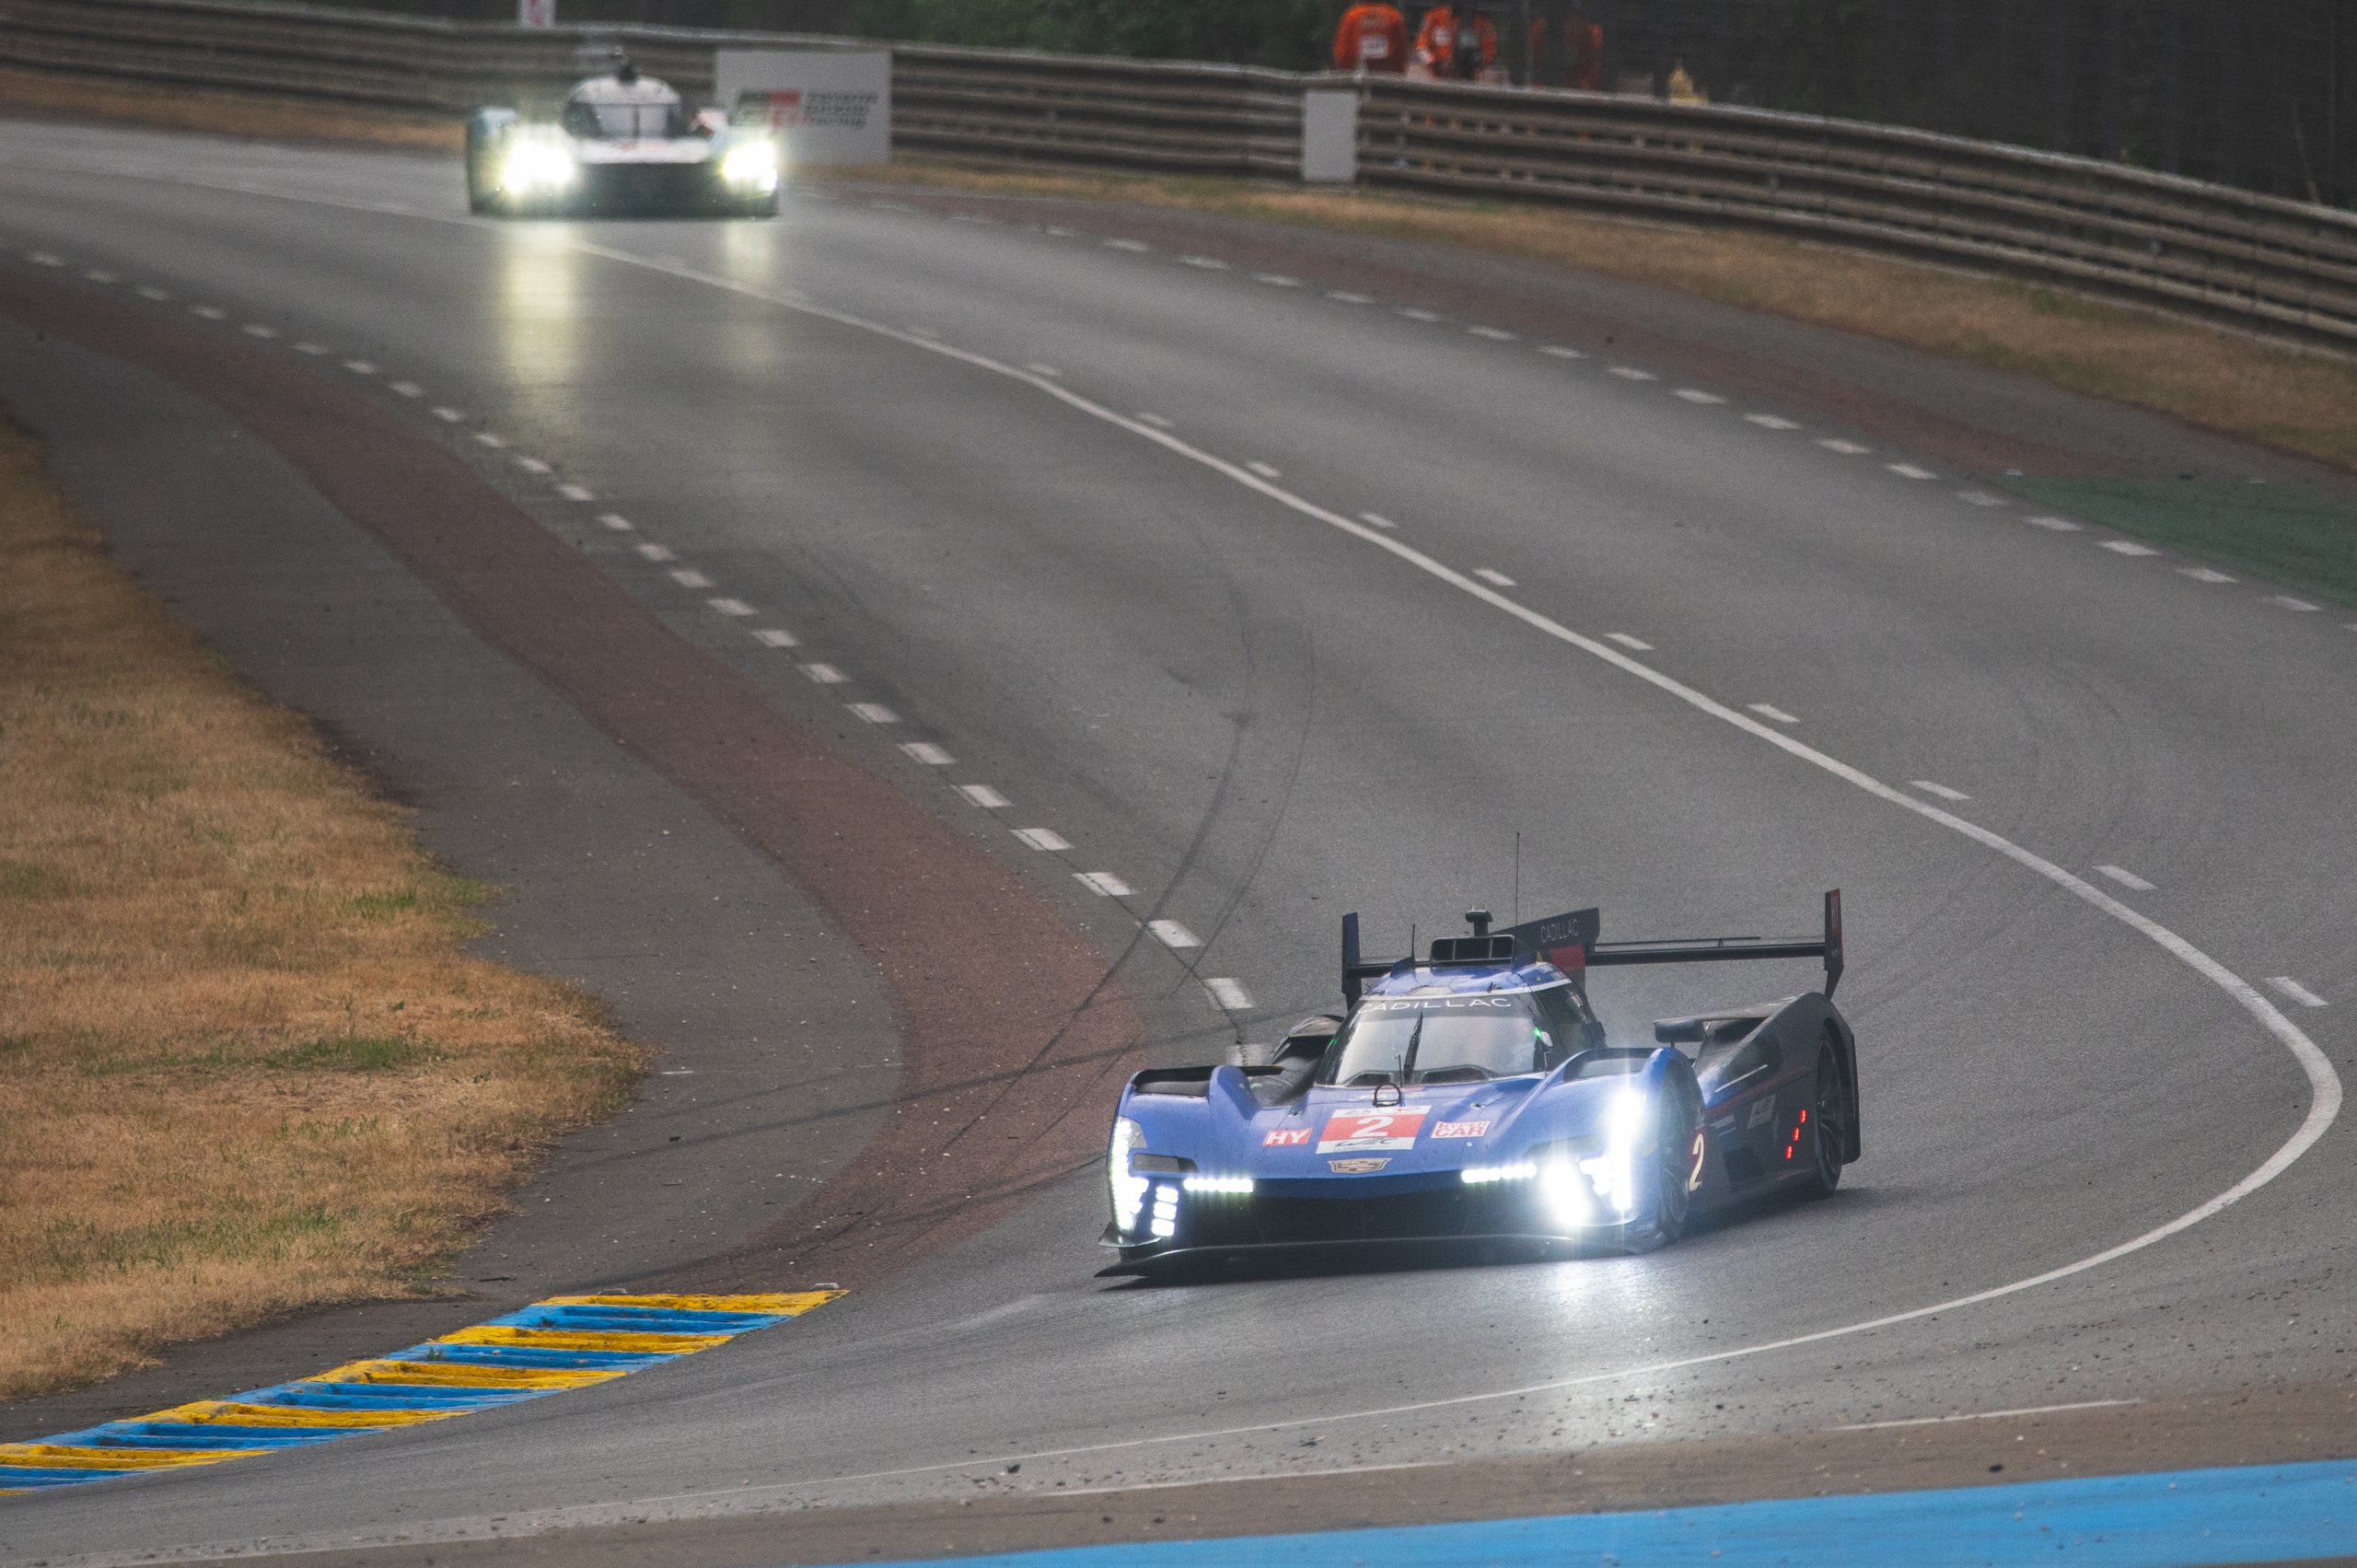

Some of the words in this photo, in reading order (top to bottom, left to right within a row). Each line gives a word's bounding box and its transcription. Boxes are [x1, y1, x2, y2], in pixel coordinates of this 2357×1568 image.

[1540, 919, 1578, 944] CADILLAC
[1357, 998, 1512, 1014] CADILLAC
[1351, 1115, 1395, 1138] 2
[1434, 1126, 1483, 1137] CAR
[1265, 1131, 1306, 1144] HY
[1689, 1132, 1704, 1191] 2
